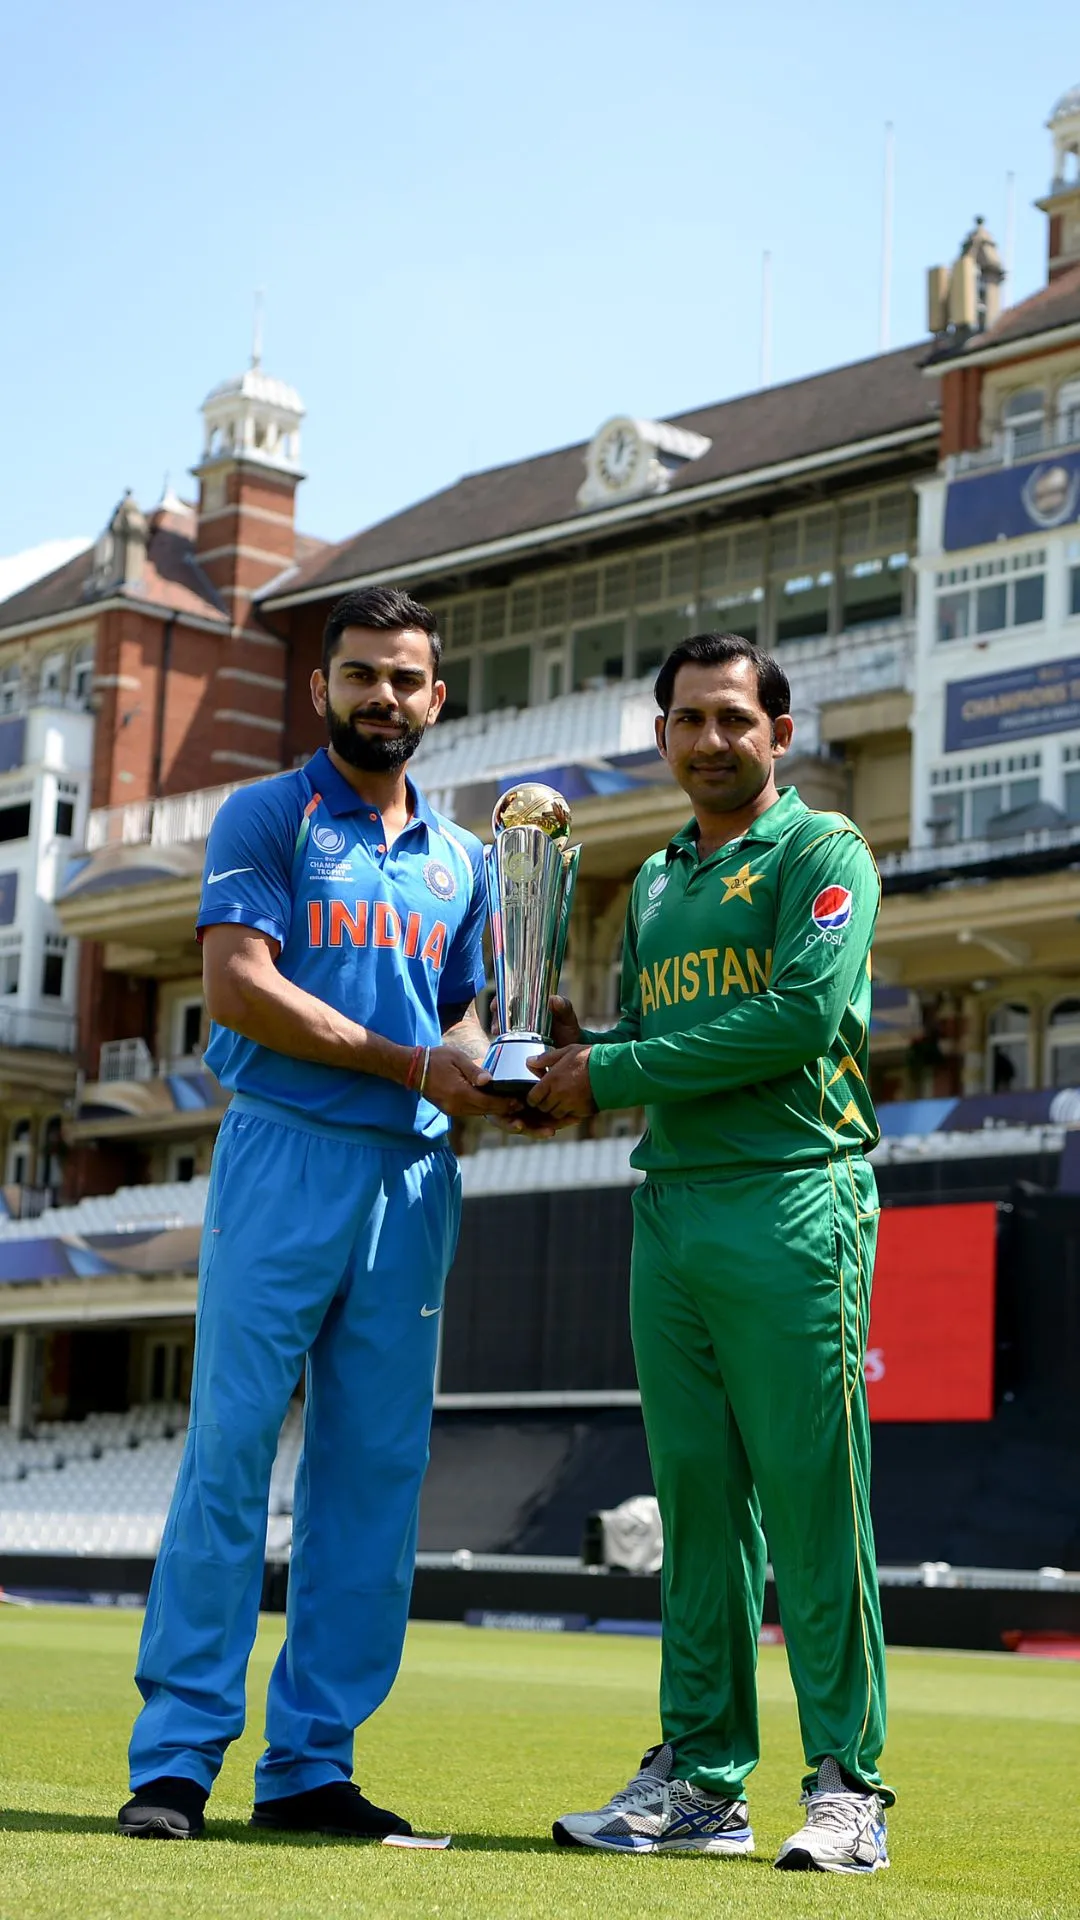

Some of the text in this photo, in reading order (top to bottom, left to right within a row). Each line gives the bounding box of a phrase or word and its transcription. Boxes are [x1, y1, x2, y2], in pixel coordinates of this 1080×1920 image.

[310, 861, 352, 870] CHAMPIONS
[307, 900, 447, 971] INDIA
[805, 931, 843, 946] ppsi
[639, 947, 772, 1016] AKISTAN
